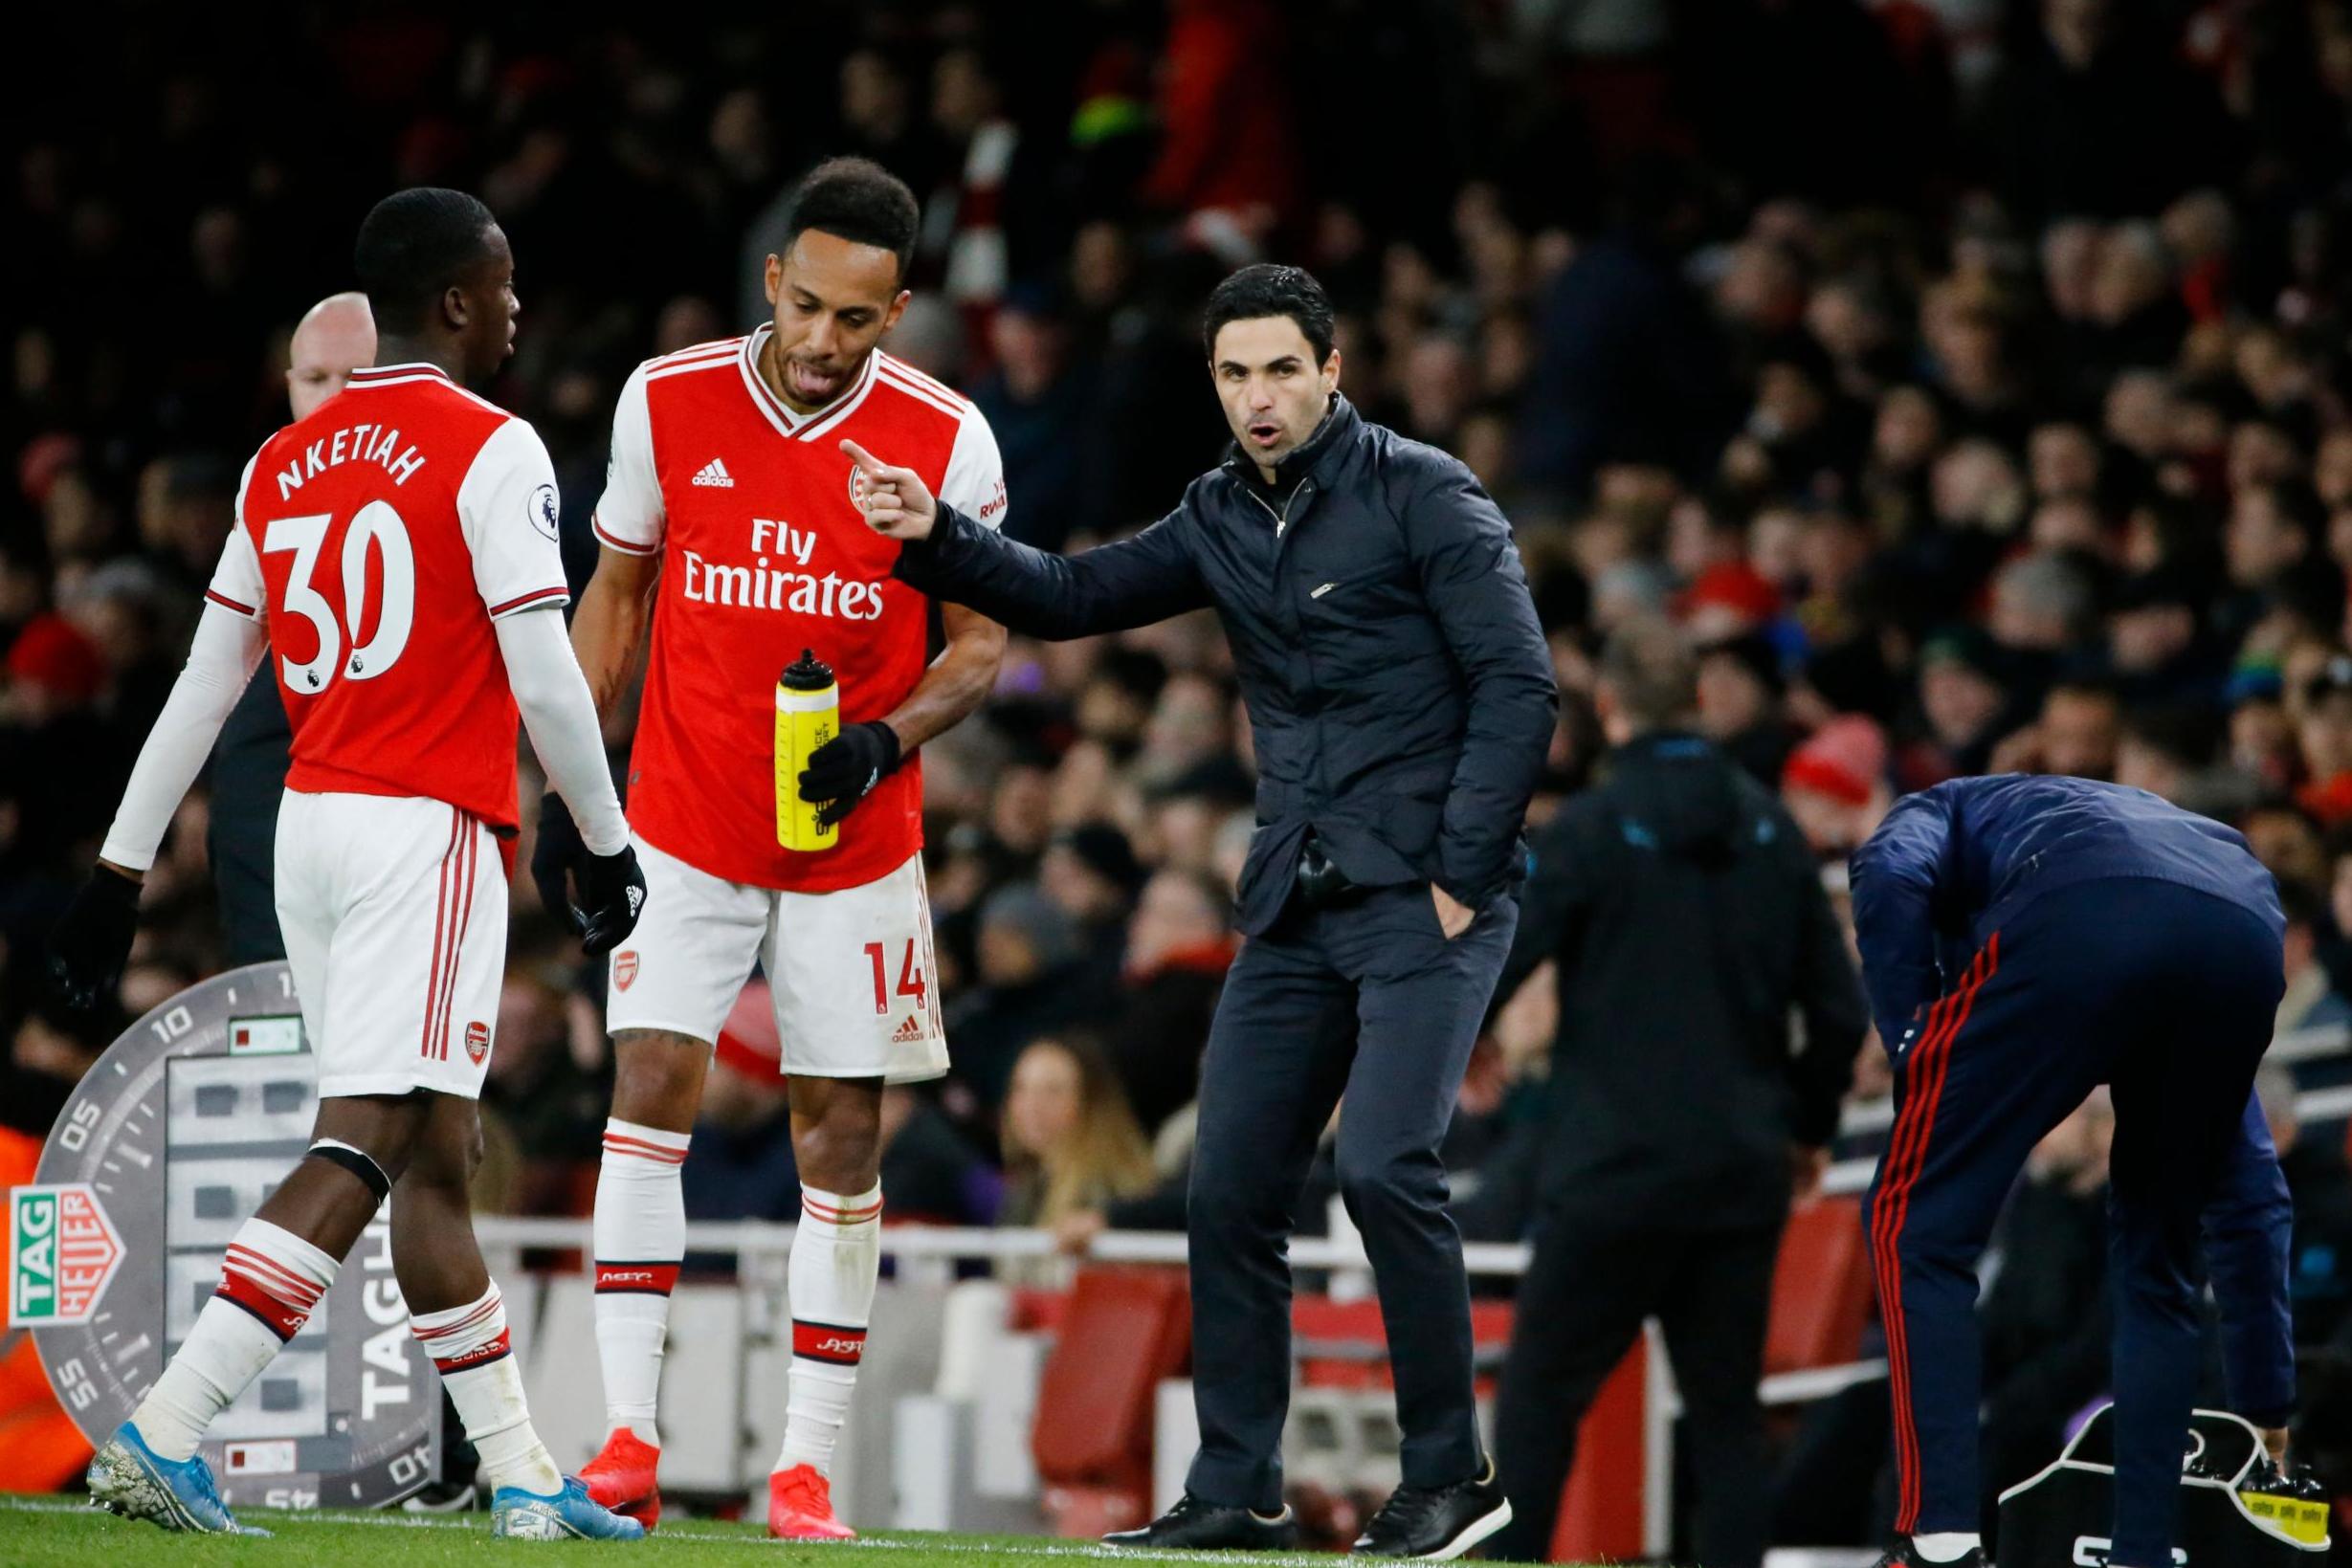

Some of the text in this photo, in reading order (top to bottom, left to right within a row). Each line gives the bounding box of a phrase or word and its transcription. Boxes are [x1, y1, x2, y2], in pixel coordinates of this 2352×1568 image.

[277, 424, 426, 501] NKETIAH
[691, 475, 734, 488] adidas
[751, 518, 816, 565] Fly
[263, 499, 415, 696] 30
[683, 550, 883, 620] Emirates
[864, 938, 925, 1014] 14
[150, 1005, 193, 1044] 10
[892, 1031, 923, 1043] adidas
[59, 1098, 100, 1152] 05
[19, 1200, 54, 1313] TAG
[61, 1195, 114, 1315] HEUER
[57, 1358, 99, 1411] 55
